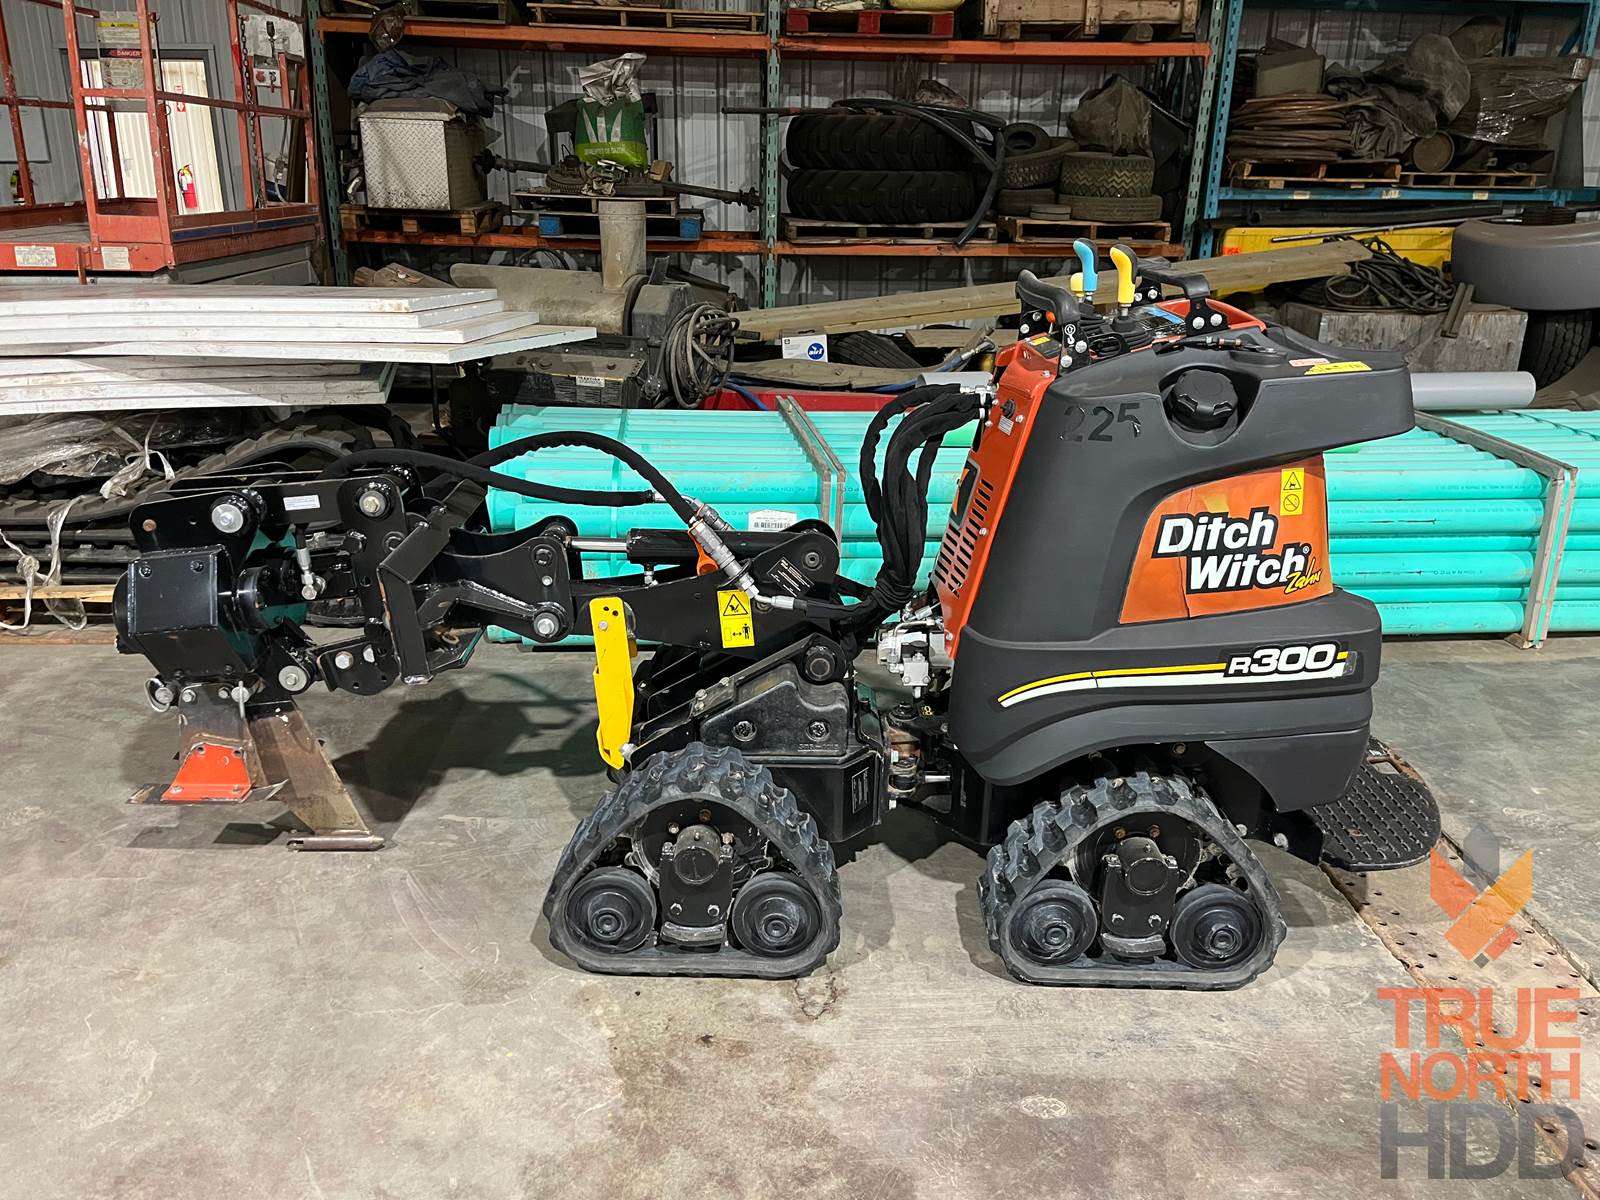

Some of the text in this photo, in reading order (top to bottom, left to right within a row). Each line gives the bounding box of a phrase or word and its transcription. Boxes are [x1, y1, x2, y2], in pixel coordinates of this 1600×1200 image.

[1060, 402, 1142, 442] 225
[1156, 510, 1275, 555] Ditch
[1284, 556, 1323, 595] Zahn
[1227, 643, 1337, 675] R300
